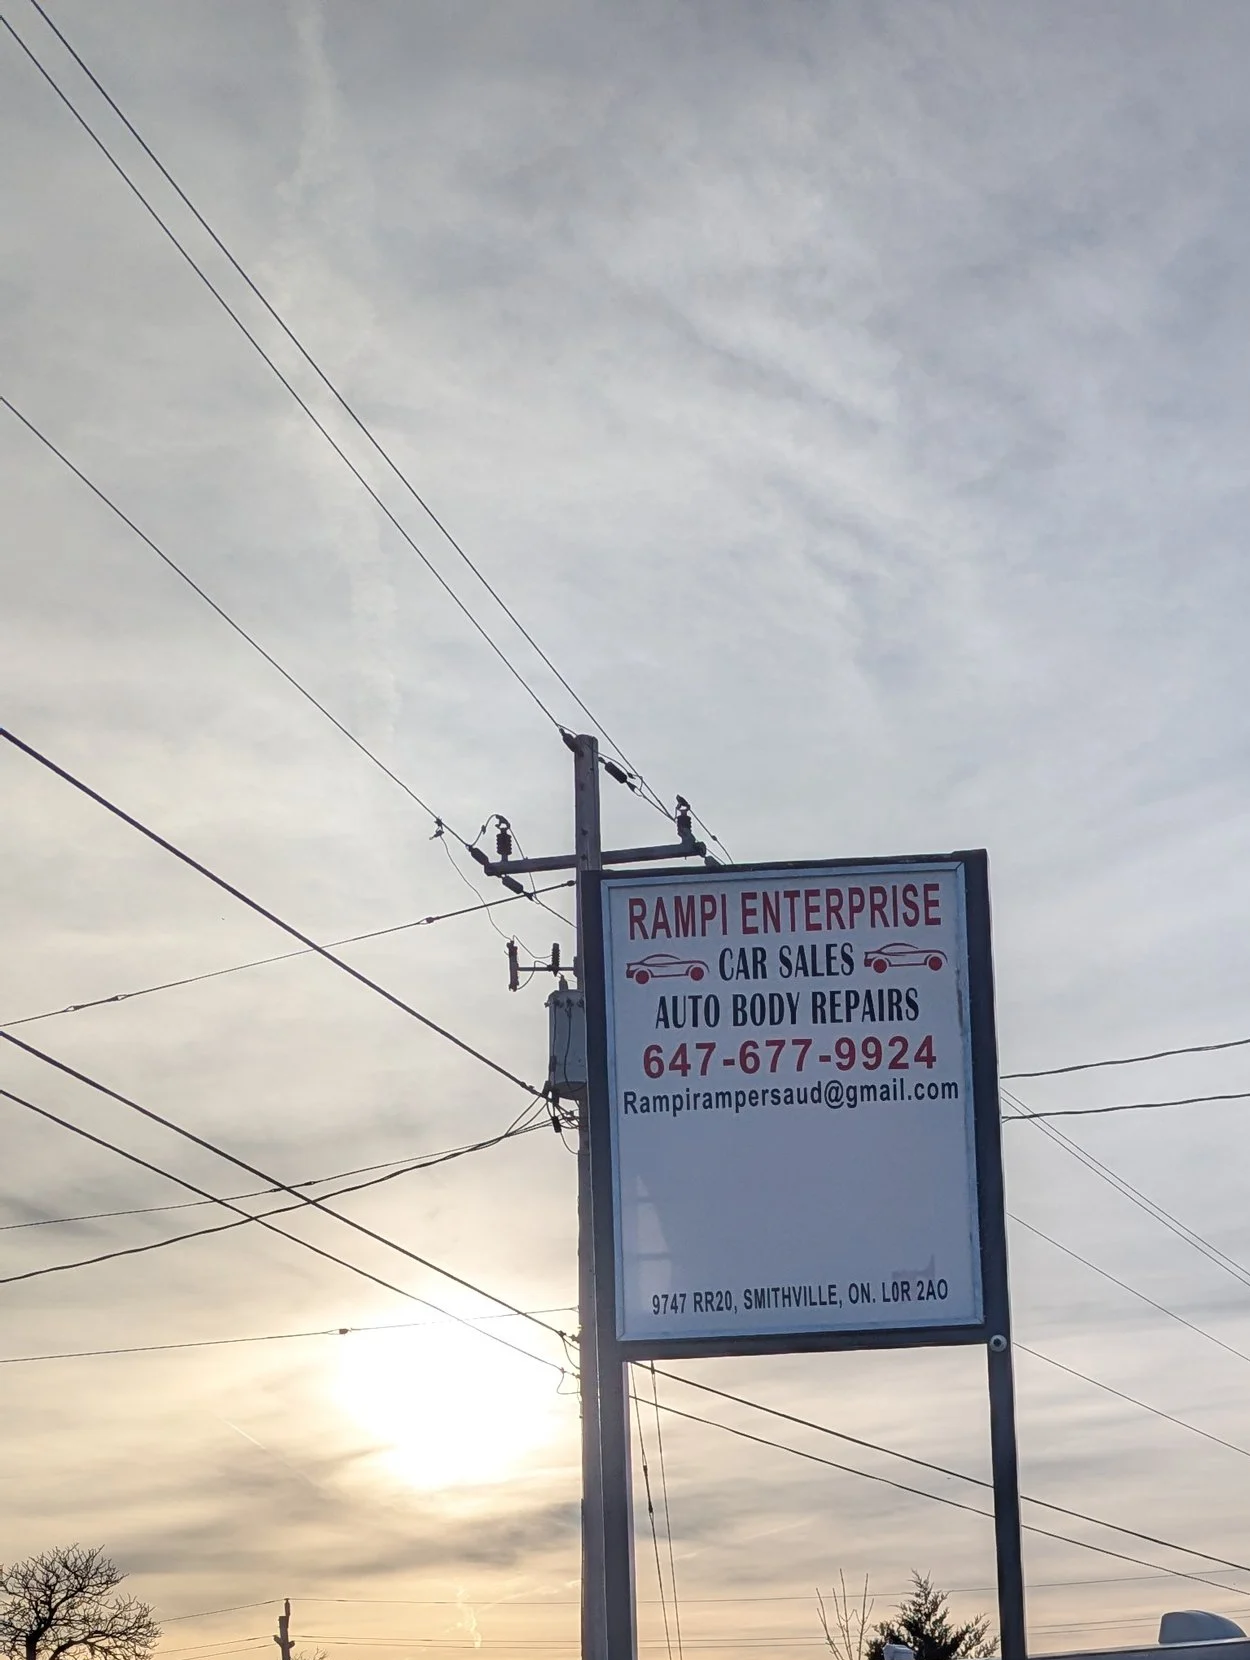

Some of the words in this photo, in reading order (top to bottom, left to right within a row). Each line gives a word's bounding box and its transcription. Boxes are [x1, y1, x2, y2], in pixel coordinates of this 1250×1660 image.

[628, 893, 727, 941] RAMPI
[741, 883, 942, 935] ENTERPRISE
[718, 946, 768, 981] CAR
[779, 942, 855, 978] SALES
[655, 994, 720, 1029] AUTO
[732, 991, 801, 1027] BODY
[811, 987, 920, 1024] REPAIRS
[643, 1035, 937, 1079] 647-677-9924
[623, 1078, 959, 1117] Rampirampersaud@gmail.com
[652, 1292, 687, 1315] 9747
[693, 1290, 738, 1315] RR20,
[743, 1284, 843, 1310] SMITHVILLE,
[848, 1281, 876, 1305] ON.
